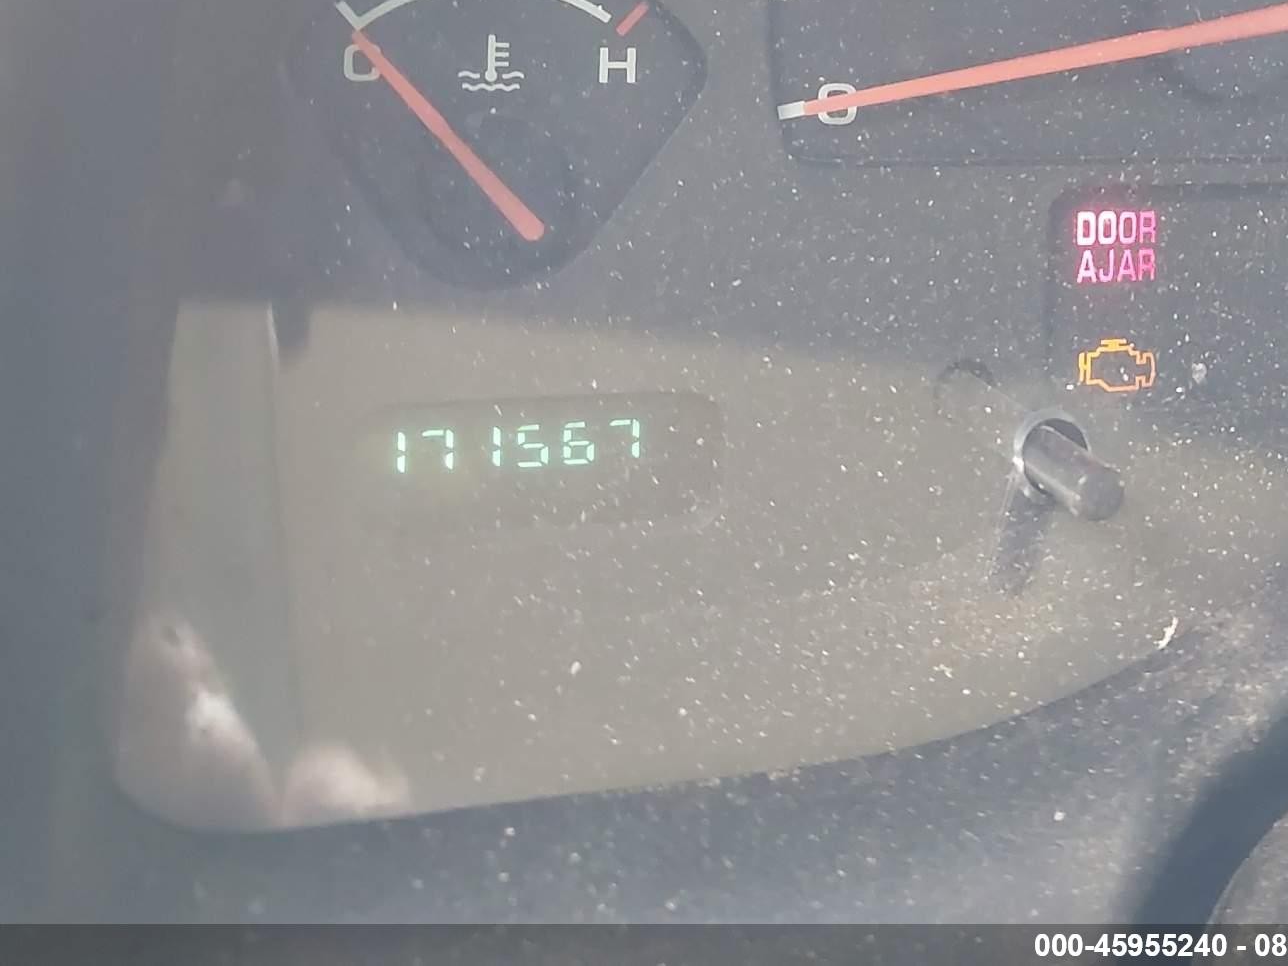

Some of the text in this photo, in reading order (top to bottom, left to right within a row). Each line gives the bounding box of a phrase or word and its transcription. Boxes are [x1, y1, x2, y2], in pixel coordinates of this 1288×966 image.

[599, 47, 637, 83] H
[817, 82, 858, 125] 0
[1076, 210, 1157, 246] DOOR
[1076, 248, 1157, 283] AJAR
[397, 418, 642, 473] 171567
